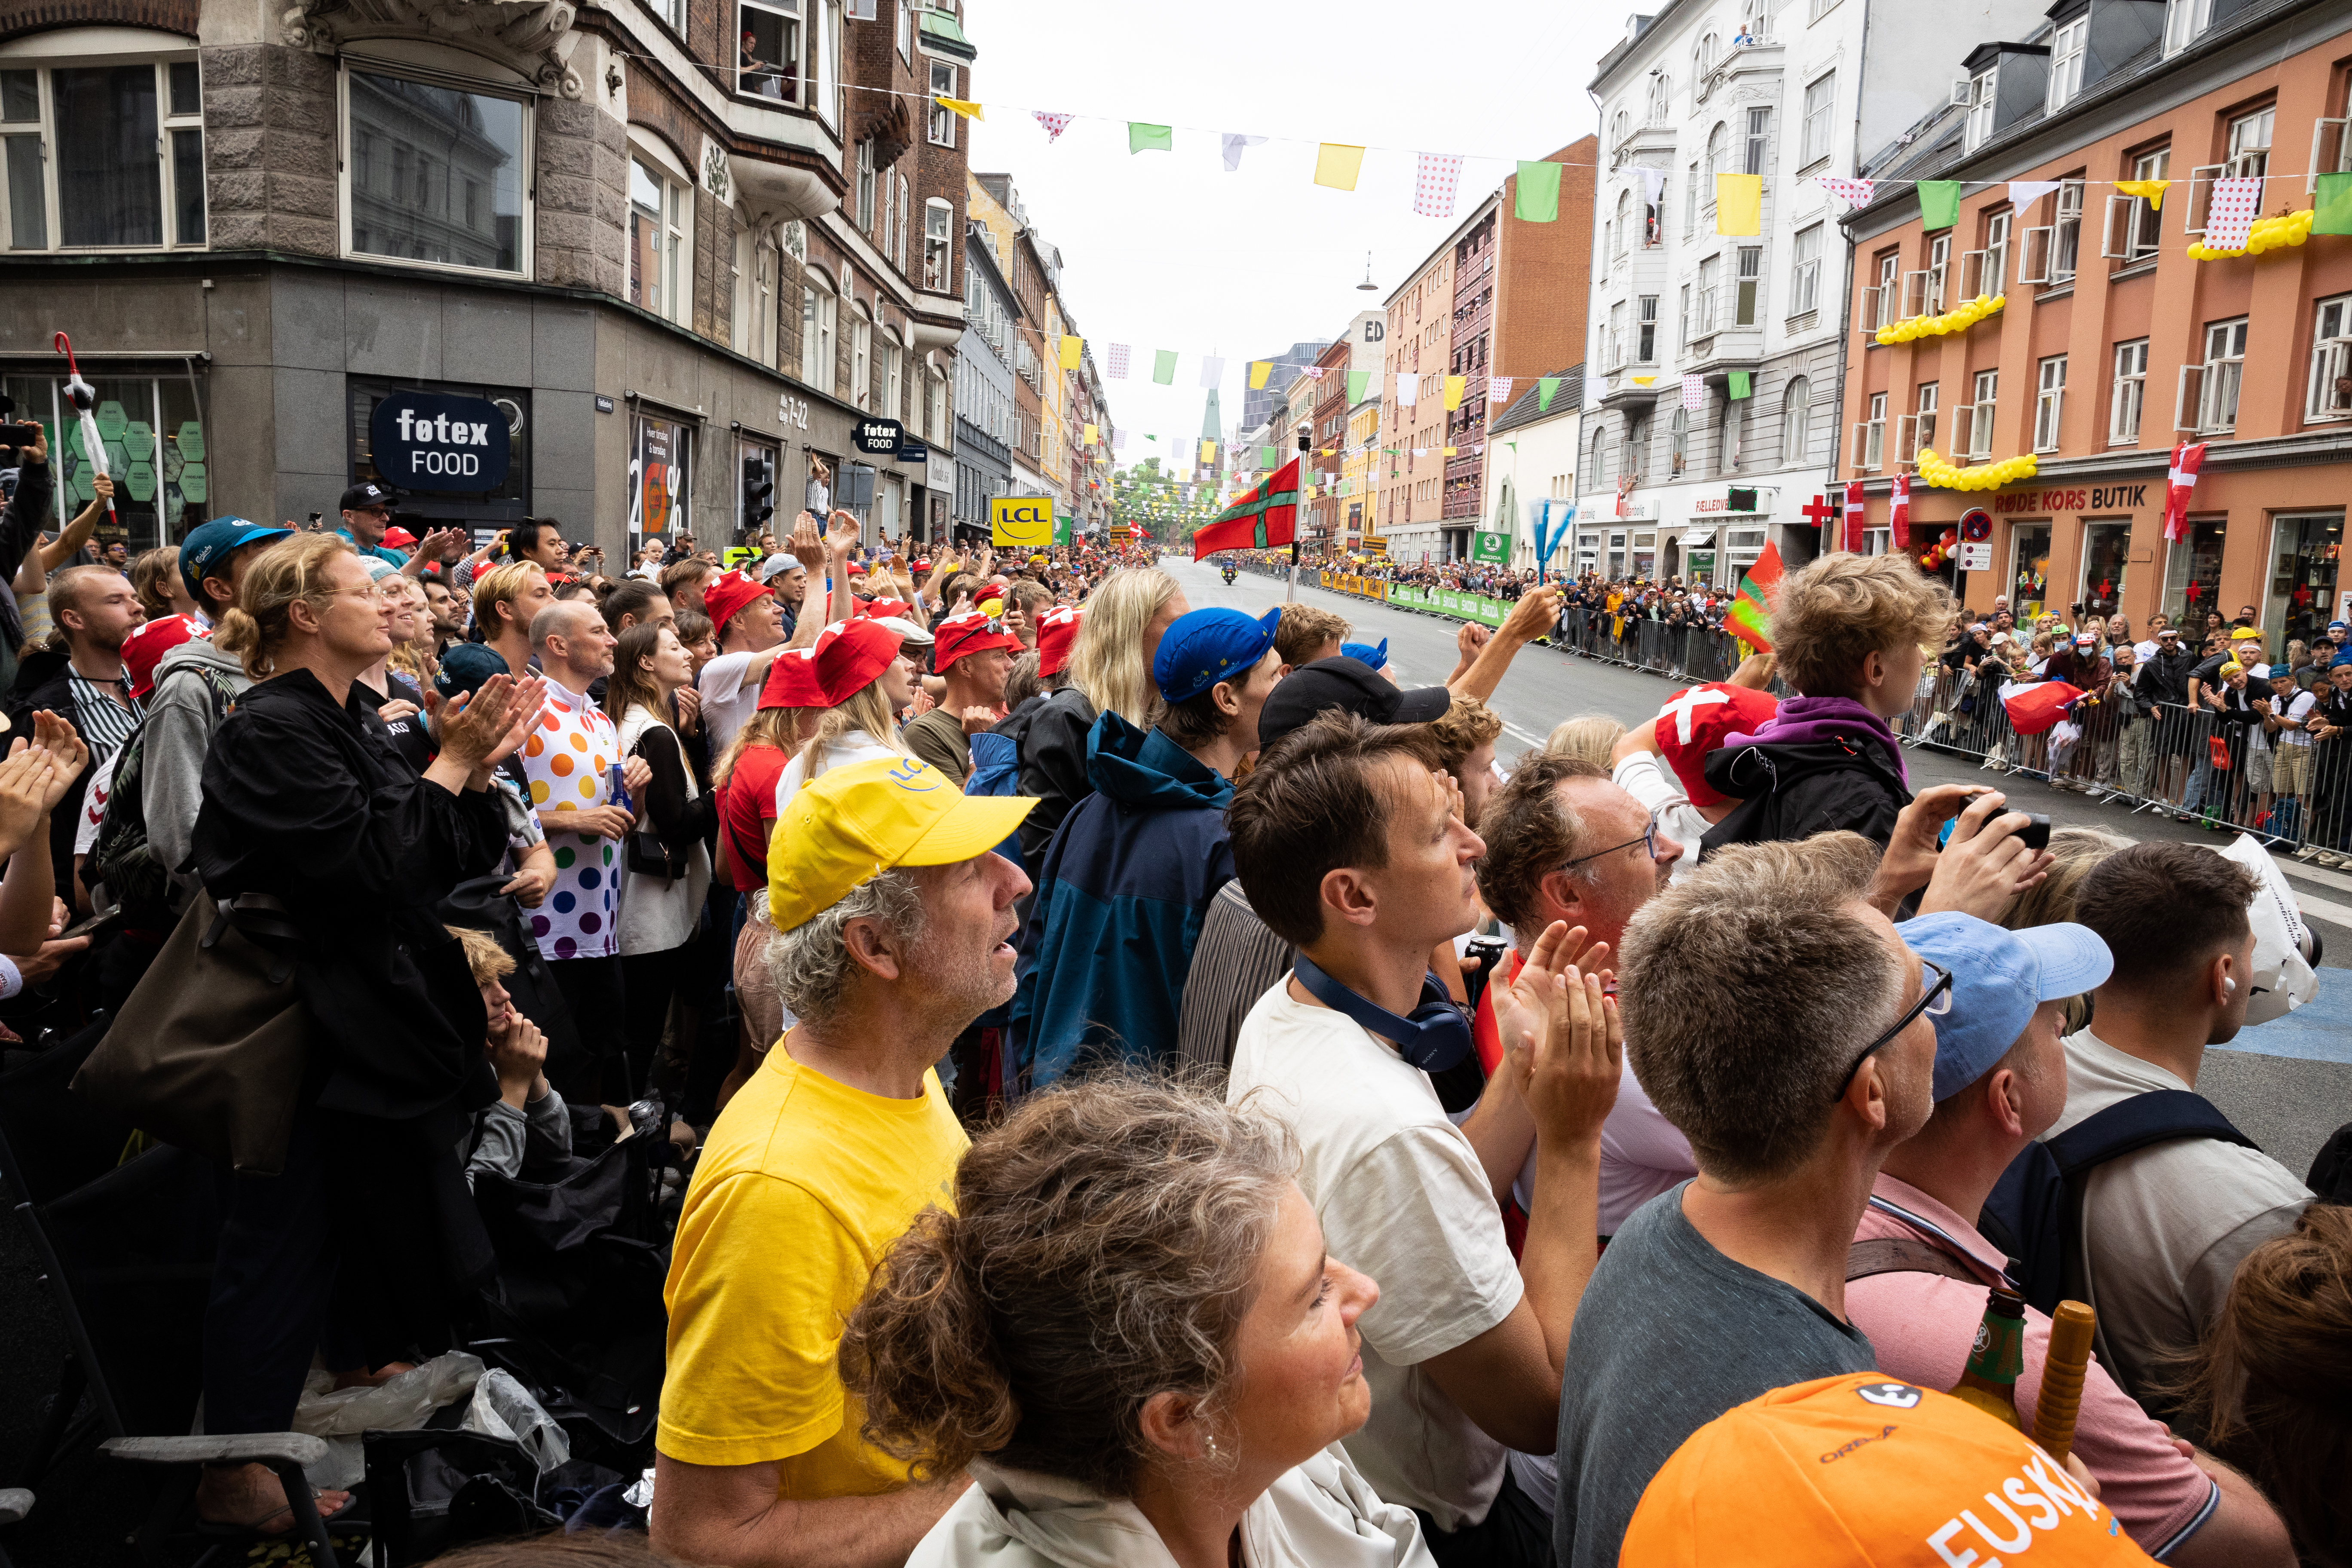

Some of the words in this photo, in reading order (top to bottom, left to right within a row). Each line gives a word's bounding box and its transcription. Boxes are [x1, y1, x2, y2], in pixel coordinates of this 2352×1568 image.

[1365, 320, 1384, 342] ED
[789, 397, 807, 430] 7-22
[397, 409, 488, 446] føtex
[647, 426, 656, 439] Hver
[656, 430, 668, 443] tirsdag
[863, 424, 896, 437] føtex
[649, 443, 652, 453] &
[652, 444, 666, 458] torsdag
[868, 439, 892, 448] FOOD
[412, 451, 478, 475] FOOD
[931, 458, 944, 482] Route
[1696, 499, 1728, 512] FÆLLEDVE
[1995, 492, 2037, 513] RØDE
[2042, 490, 2086, 511] KORS
[2092, 485, 2147, 509] BUTIK
[1002, 508, 1047, 523] LCL
[1580, 508, 1595, 520] danbolig
[1626, 504, 1645, 518] danbolig
[1399, 588, 1411, 601] ŠKODA
[1413, 591, 1424, 603] ŠKODA
[1443, 594, 1458, 609] ŠKODA
[1461, 597, 1477, 613] ŠKODA
[1482, 601, 1498, 619] ŠKODA
[1219, 660, 1240, 678] Oddset
[1422, 1048, 1438, 1064] SONY
